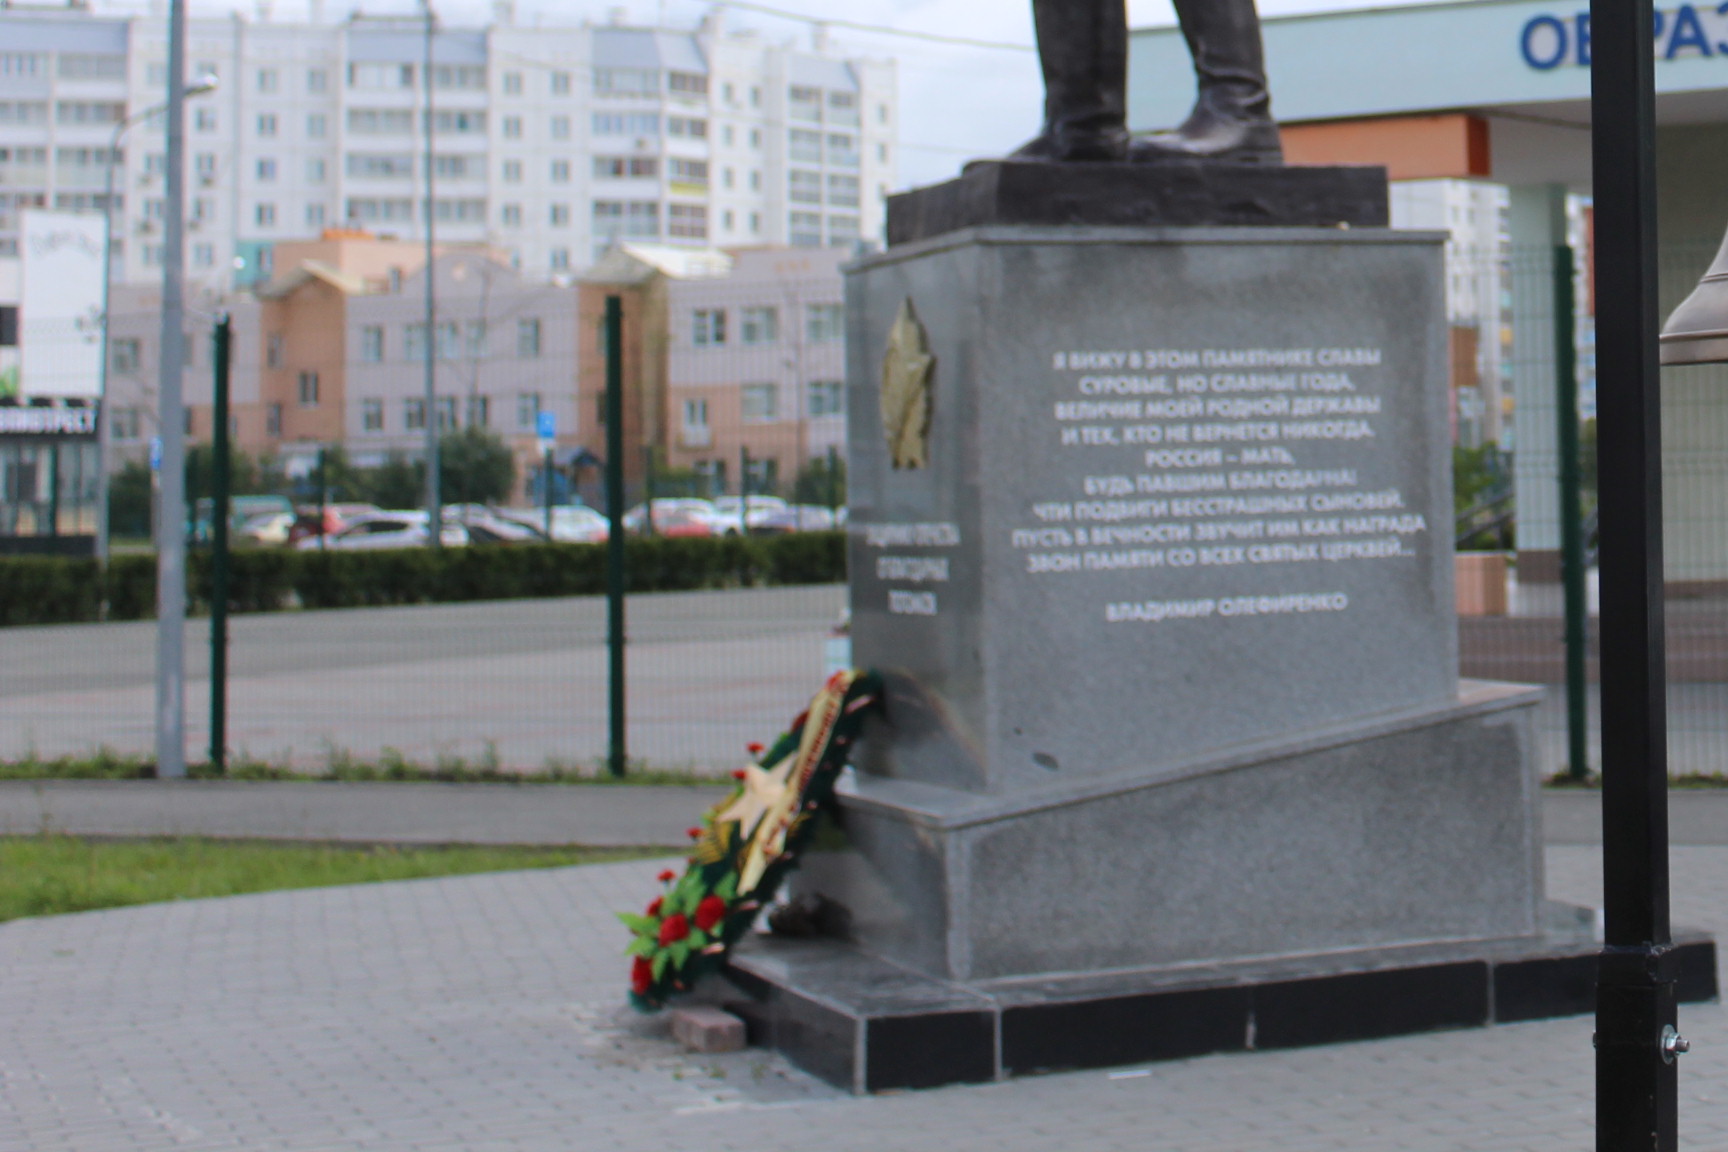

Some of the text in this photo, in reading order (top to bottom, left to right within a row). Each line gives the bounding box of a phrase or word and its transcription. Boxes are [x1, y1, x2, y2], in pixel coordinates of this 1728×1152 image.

[1069, 351, 1126, 370] ВИЖУ
[1129, 351, 1142, 369] В
[1144, 350, 1199, 369] ЭТОМ
[1202, 349, 1313, 368] ПАМЯТНИКЕ
[1317, 348, 1381, 366] СЛАВЫ
[1177, 374, 1208, 393] НО
[1210, 373, 1296, 392] СЛАВНЫЕ
[1054, 394, 1381, 420] ВЕЛИЧИЕ МОЕЙ РОДНОЙ ДЕРЖАВЫ
[1061, 428, 1078, 445] И
[1123, 425, 1162, 443] КТО
[1165, 425, 1188, 442] НЕ
[1145, 449, 1222, 467] РОССИЯ
[1084, 476, 1134, 496] БУДЬ
[1137, 473, 1226, 492] ПАВШИМ
[1033, 502, 1071, 520] ЧТИ
[1074, 500, 1168, 521] ПОДВИГИ
[1171, 495, 1307, 516] БЕССТРАШНЫХ
[1012, 514, 1426, 548] ПУСТЬ В ВЕЧНОСТИ ЗВУЧИТ ИМ КАК НАГРАДА
[1027, 553, 1080, 573] ЗВОН
[1083, 549, 1163, 570] ПАМЯТИ
[1167, 547, 1196, 566] СО
[1199, 546, 1244, 565] ВСЕХ
[1248, 543, 1319, 563] СВЯТЫХ
[1106, 592, 1348, 622] ВЛАДИМИР ОЛЕФИРЕНКО
